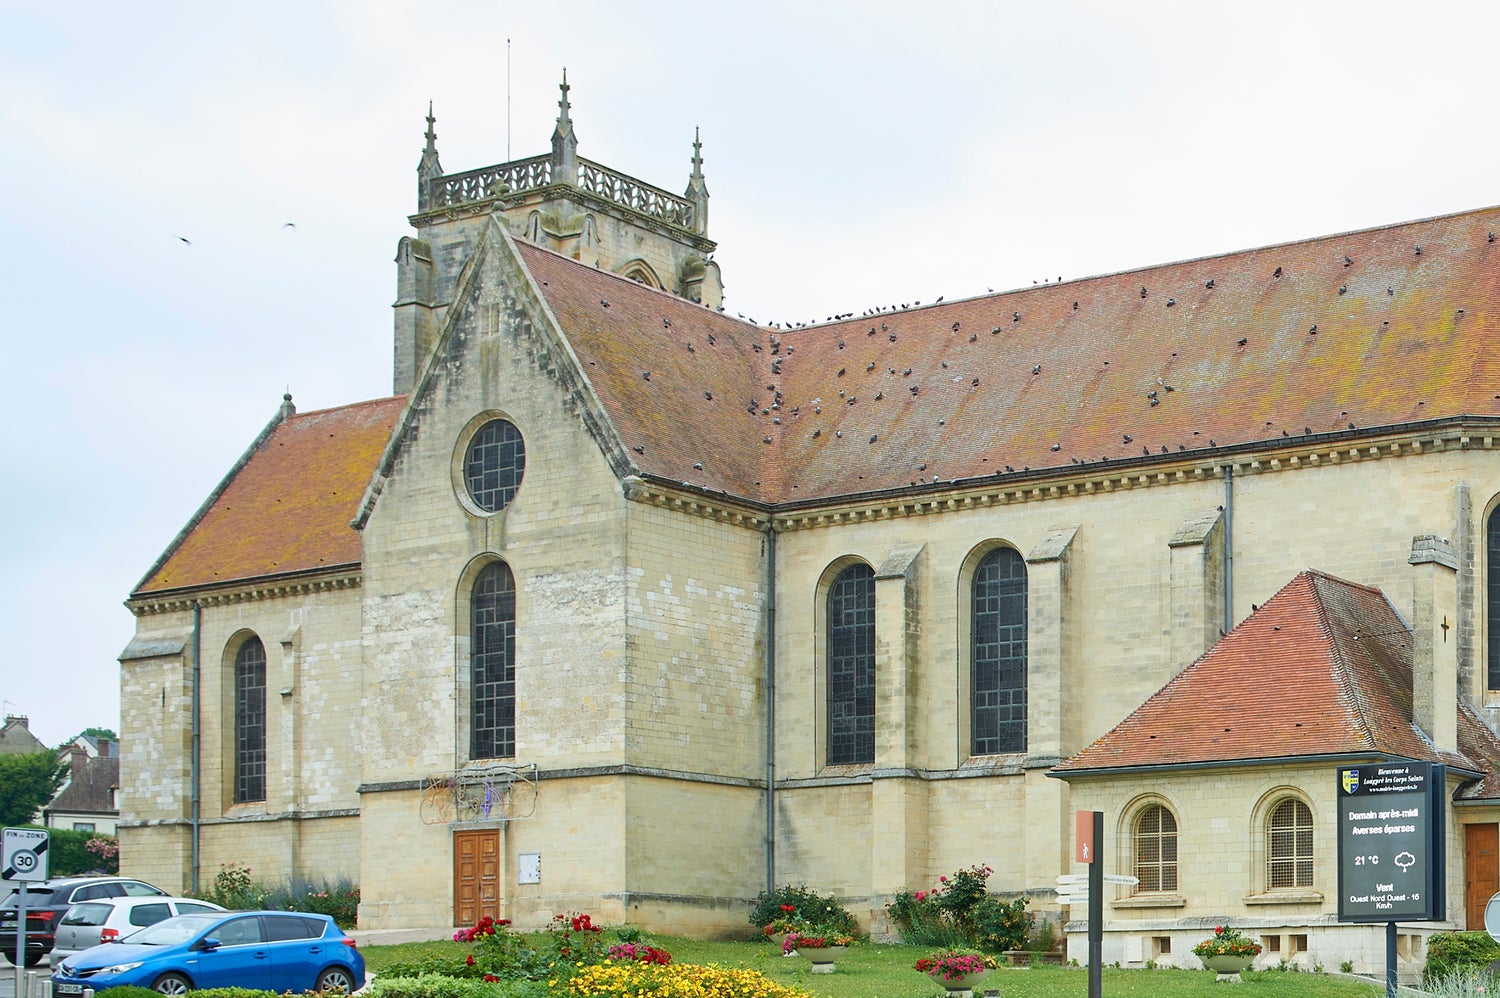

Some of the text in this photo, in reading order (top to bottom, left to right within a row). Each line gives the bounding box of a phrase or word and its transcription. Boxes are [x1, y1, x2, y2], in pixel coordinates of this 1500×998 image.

[1349, 808, 1418, 820] Demain après-midi
[1352, 824, 1415, 835] Averses éparses
[16, 856, 33, 867] 30
[1354, 855, 1379, 865] 21 °C
[1376, 884, 1394, 892] Vent
